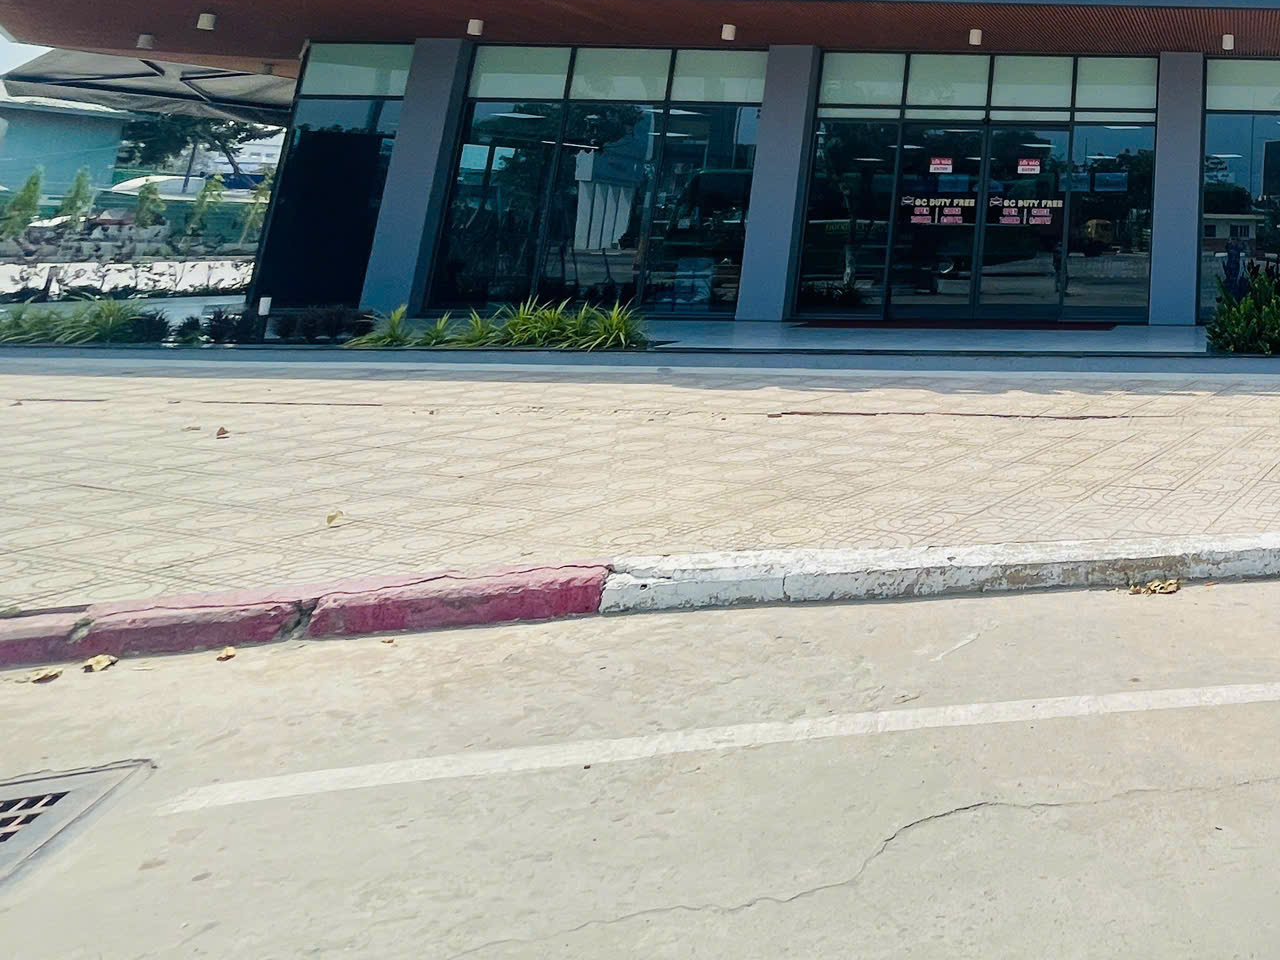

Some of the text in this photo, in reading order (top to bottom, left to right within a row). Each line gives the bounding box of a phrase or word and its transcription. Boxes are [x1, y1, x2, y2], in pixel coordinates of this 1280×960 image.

[915, 198, 976, 207] GC DUTY FREE
[1003, 199, 1064, 208] GC DUTY FREE
